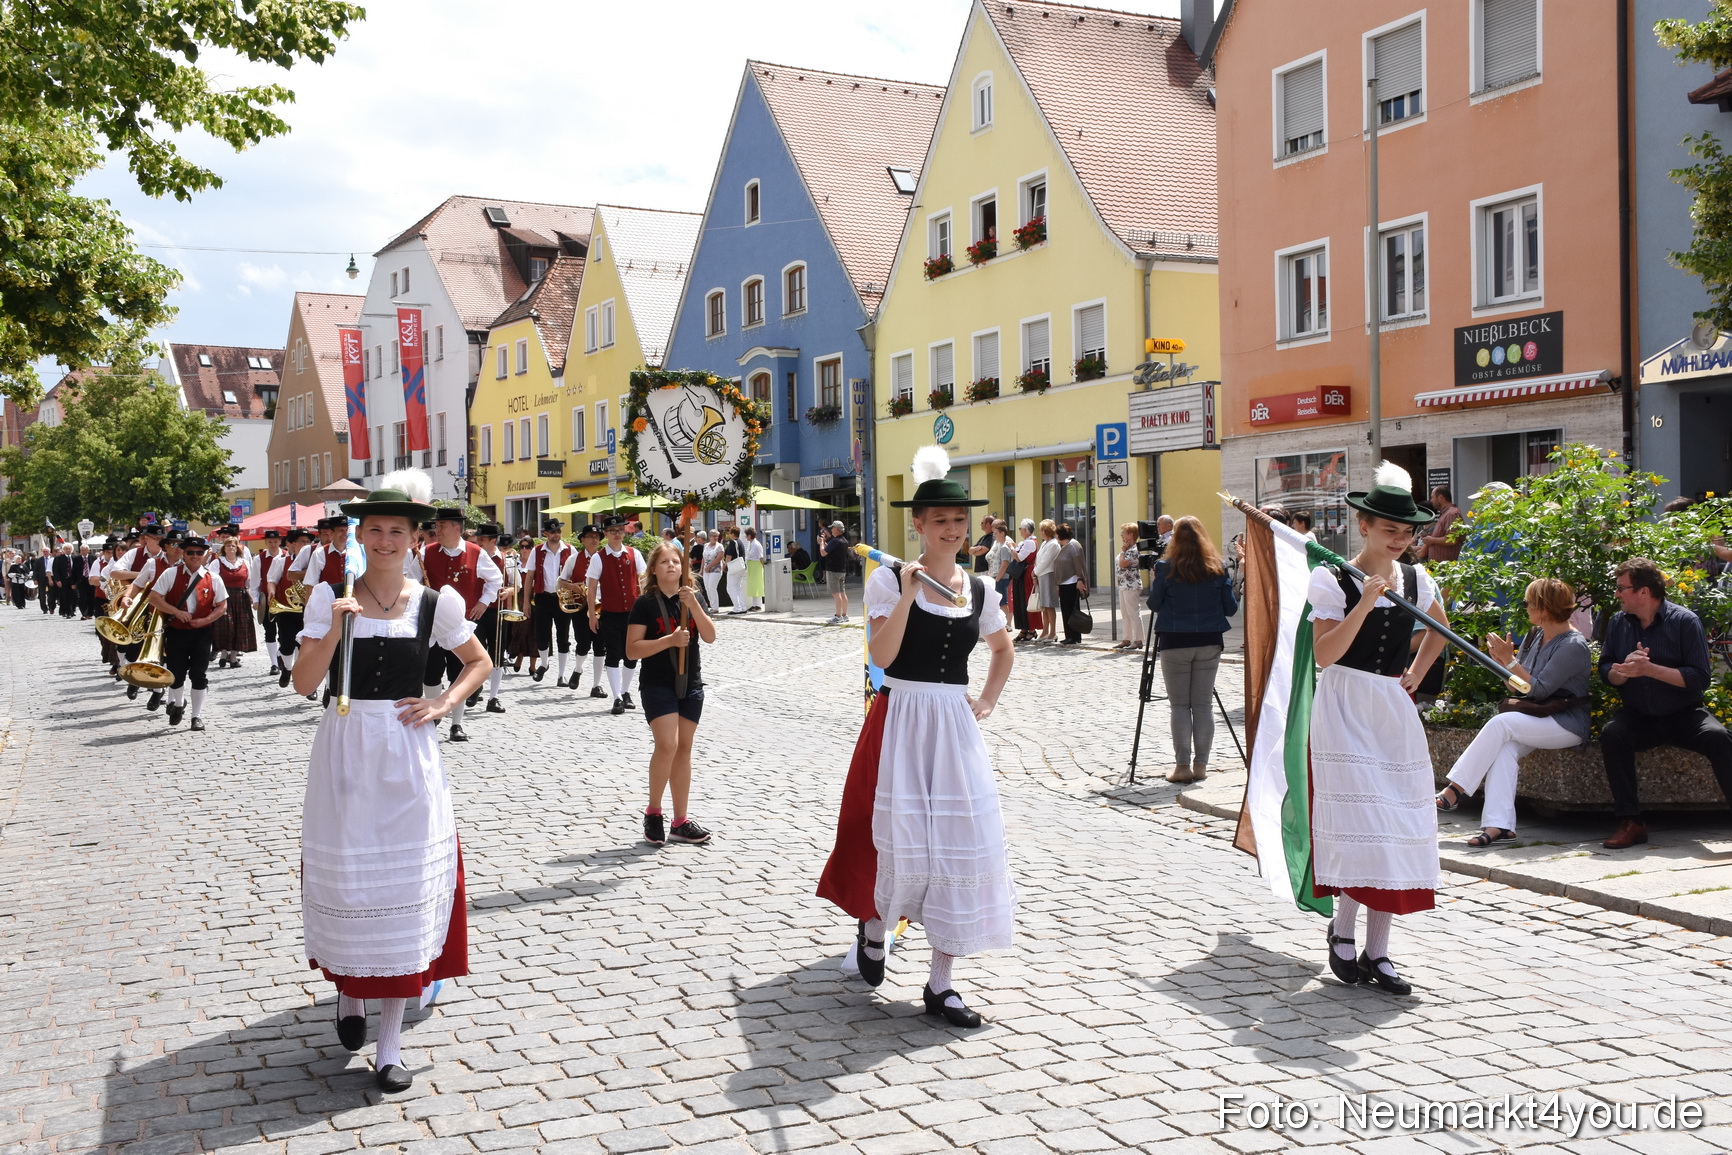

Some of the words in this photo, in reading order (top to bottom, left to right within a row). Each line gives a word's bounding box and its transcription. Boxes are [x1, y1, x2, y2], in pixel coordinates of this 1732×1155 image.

[401, 313, 414, 347] K&L
[1153, 341, 1171, 351] KINO
[1472, 370, 1495, 380] OBST
[1496, 369, 1502, 377] &
[1505, 363, 1542, 376] GEMÜSE
[1660, 350, 1732, 376] MÜHLBAU
[508, 395, 529, 414] HOTEL
[534, 391, 558, 408] Lehmeier
[1296, 395, 1317, 405] Deutsch
[1141, 414, 1168, 429] RIALTO
[1170, 410, 1191, 424] KINO
[1205, 385, 1213, 444] KINO
[1296, 406, 1318, 416] Reisebü
[1395, 422, 1402, 431] 15
[1650, 414, 1663, 428] 16
[1103, 427, 1121, 456] P
[709, 451, 747, 491] PÖLLING
[507, 480, 537, 492] Restaurant
[774, 537, 780, 547] P
